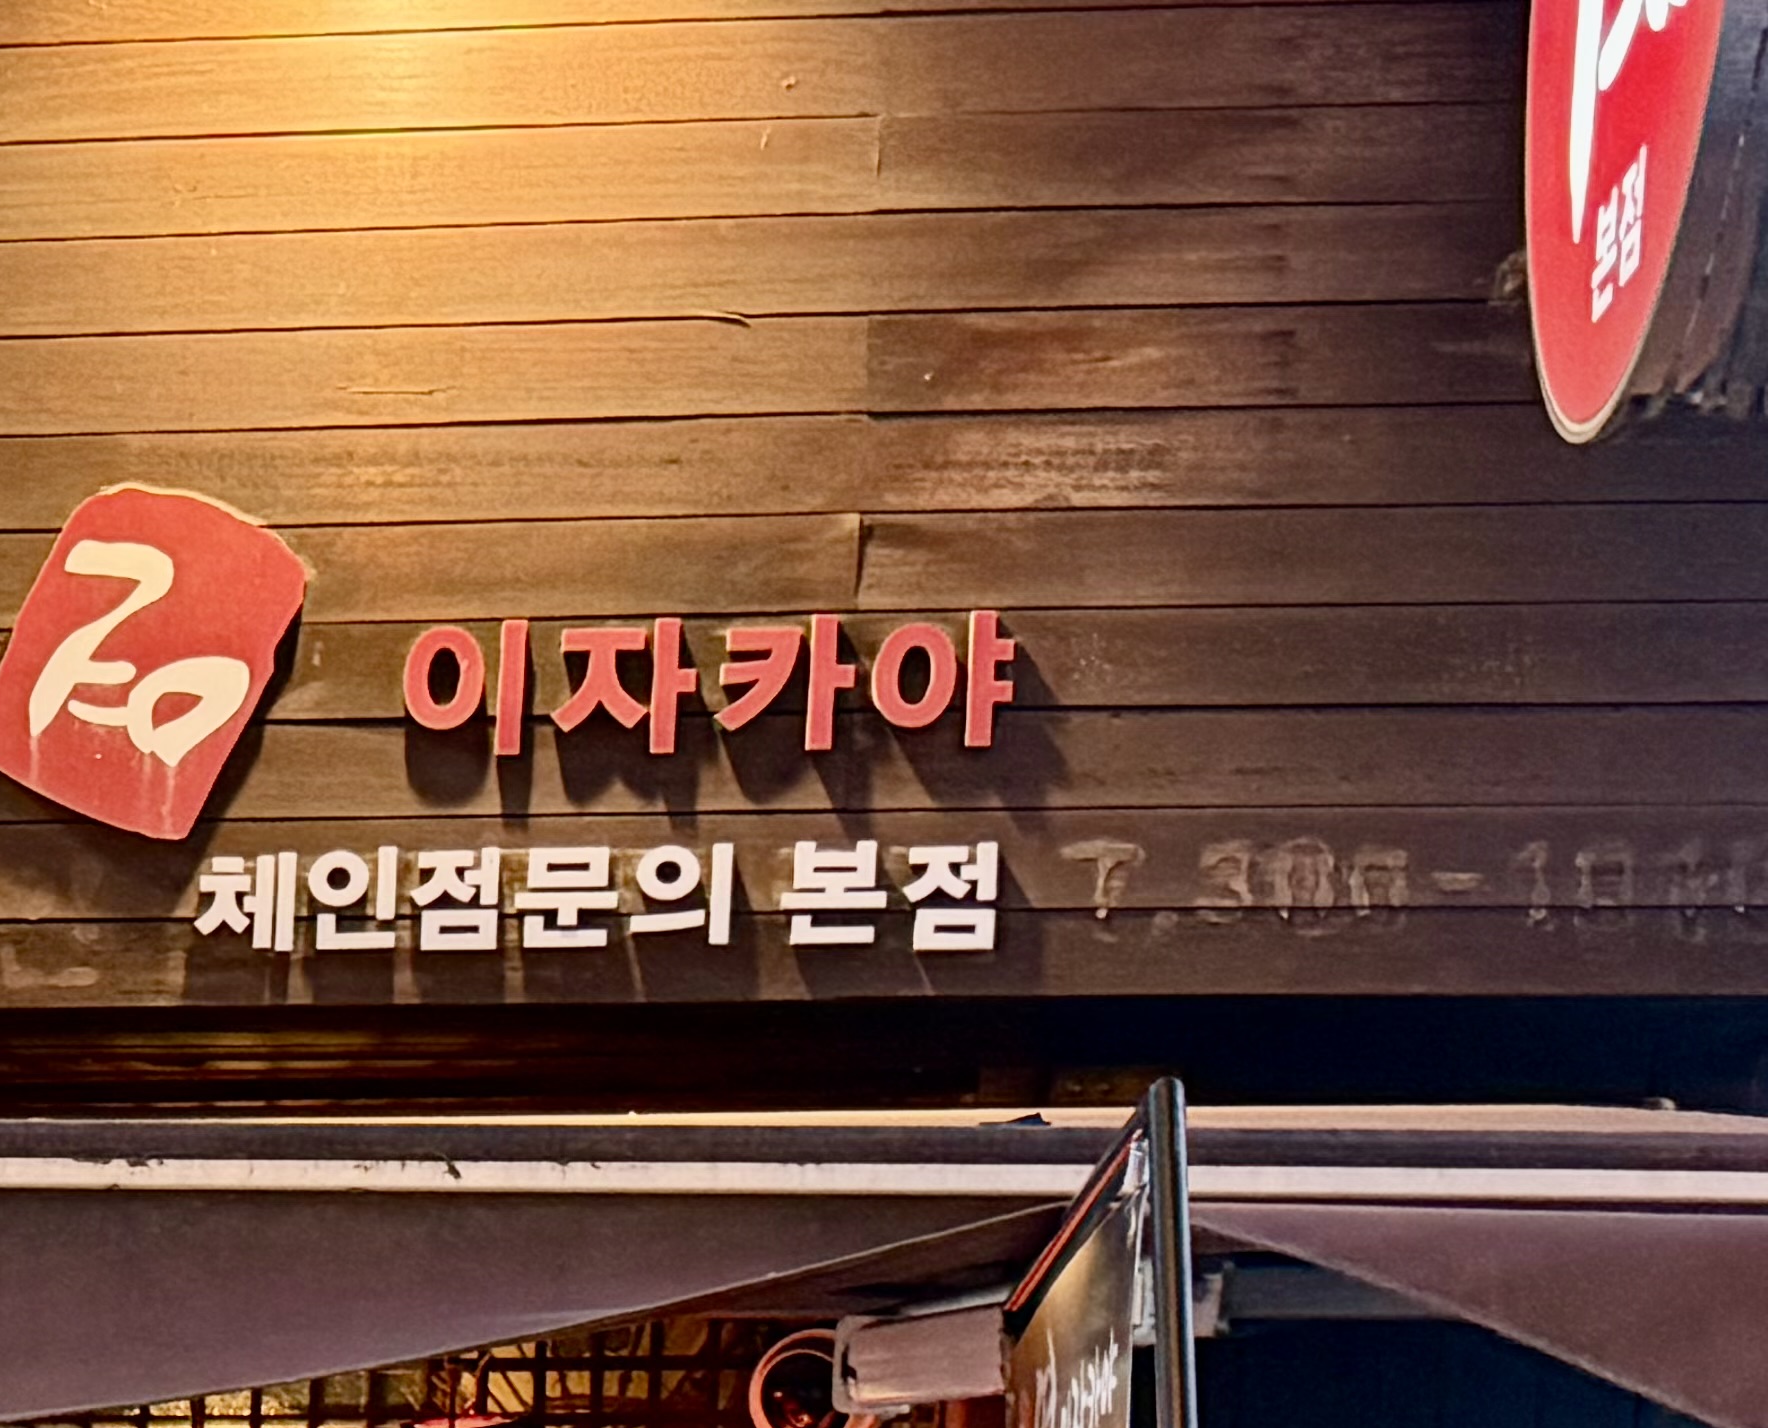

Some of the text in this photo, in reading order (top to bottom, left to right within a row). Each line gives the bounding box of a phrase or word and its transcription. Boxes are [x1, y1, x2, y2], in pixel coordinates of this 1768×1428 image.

[1591, 143, 1647, 323] 본점
[403, 610, 1015, 756] 이자카야
[194, 842, 734, 952] 체인점문의
[779, 840, 999, 951] 본점
